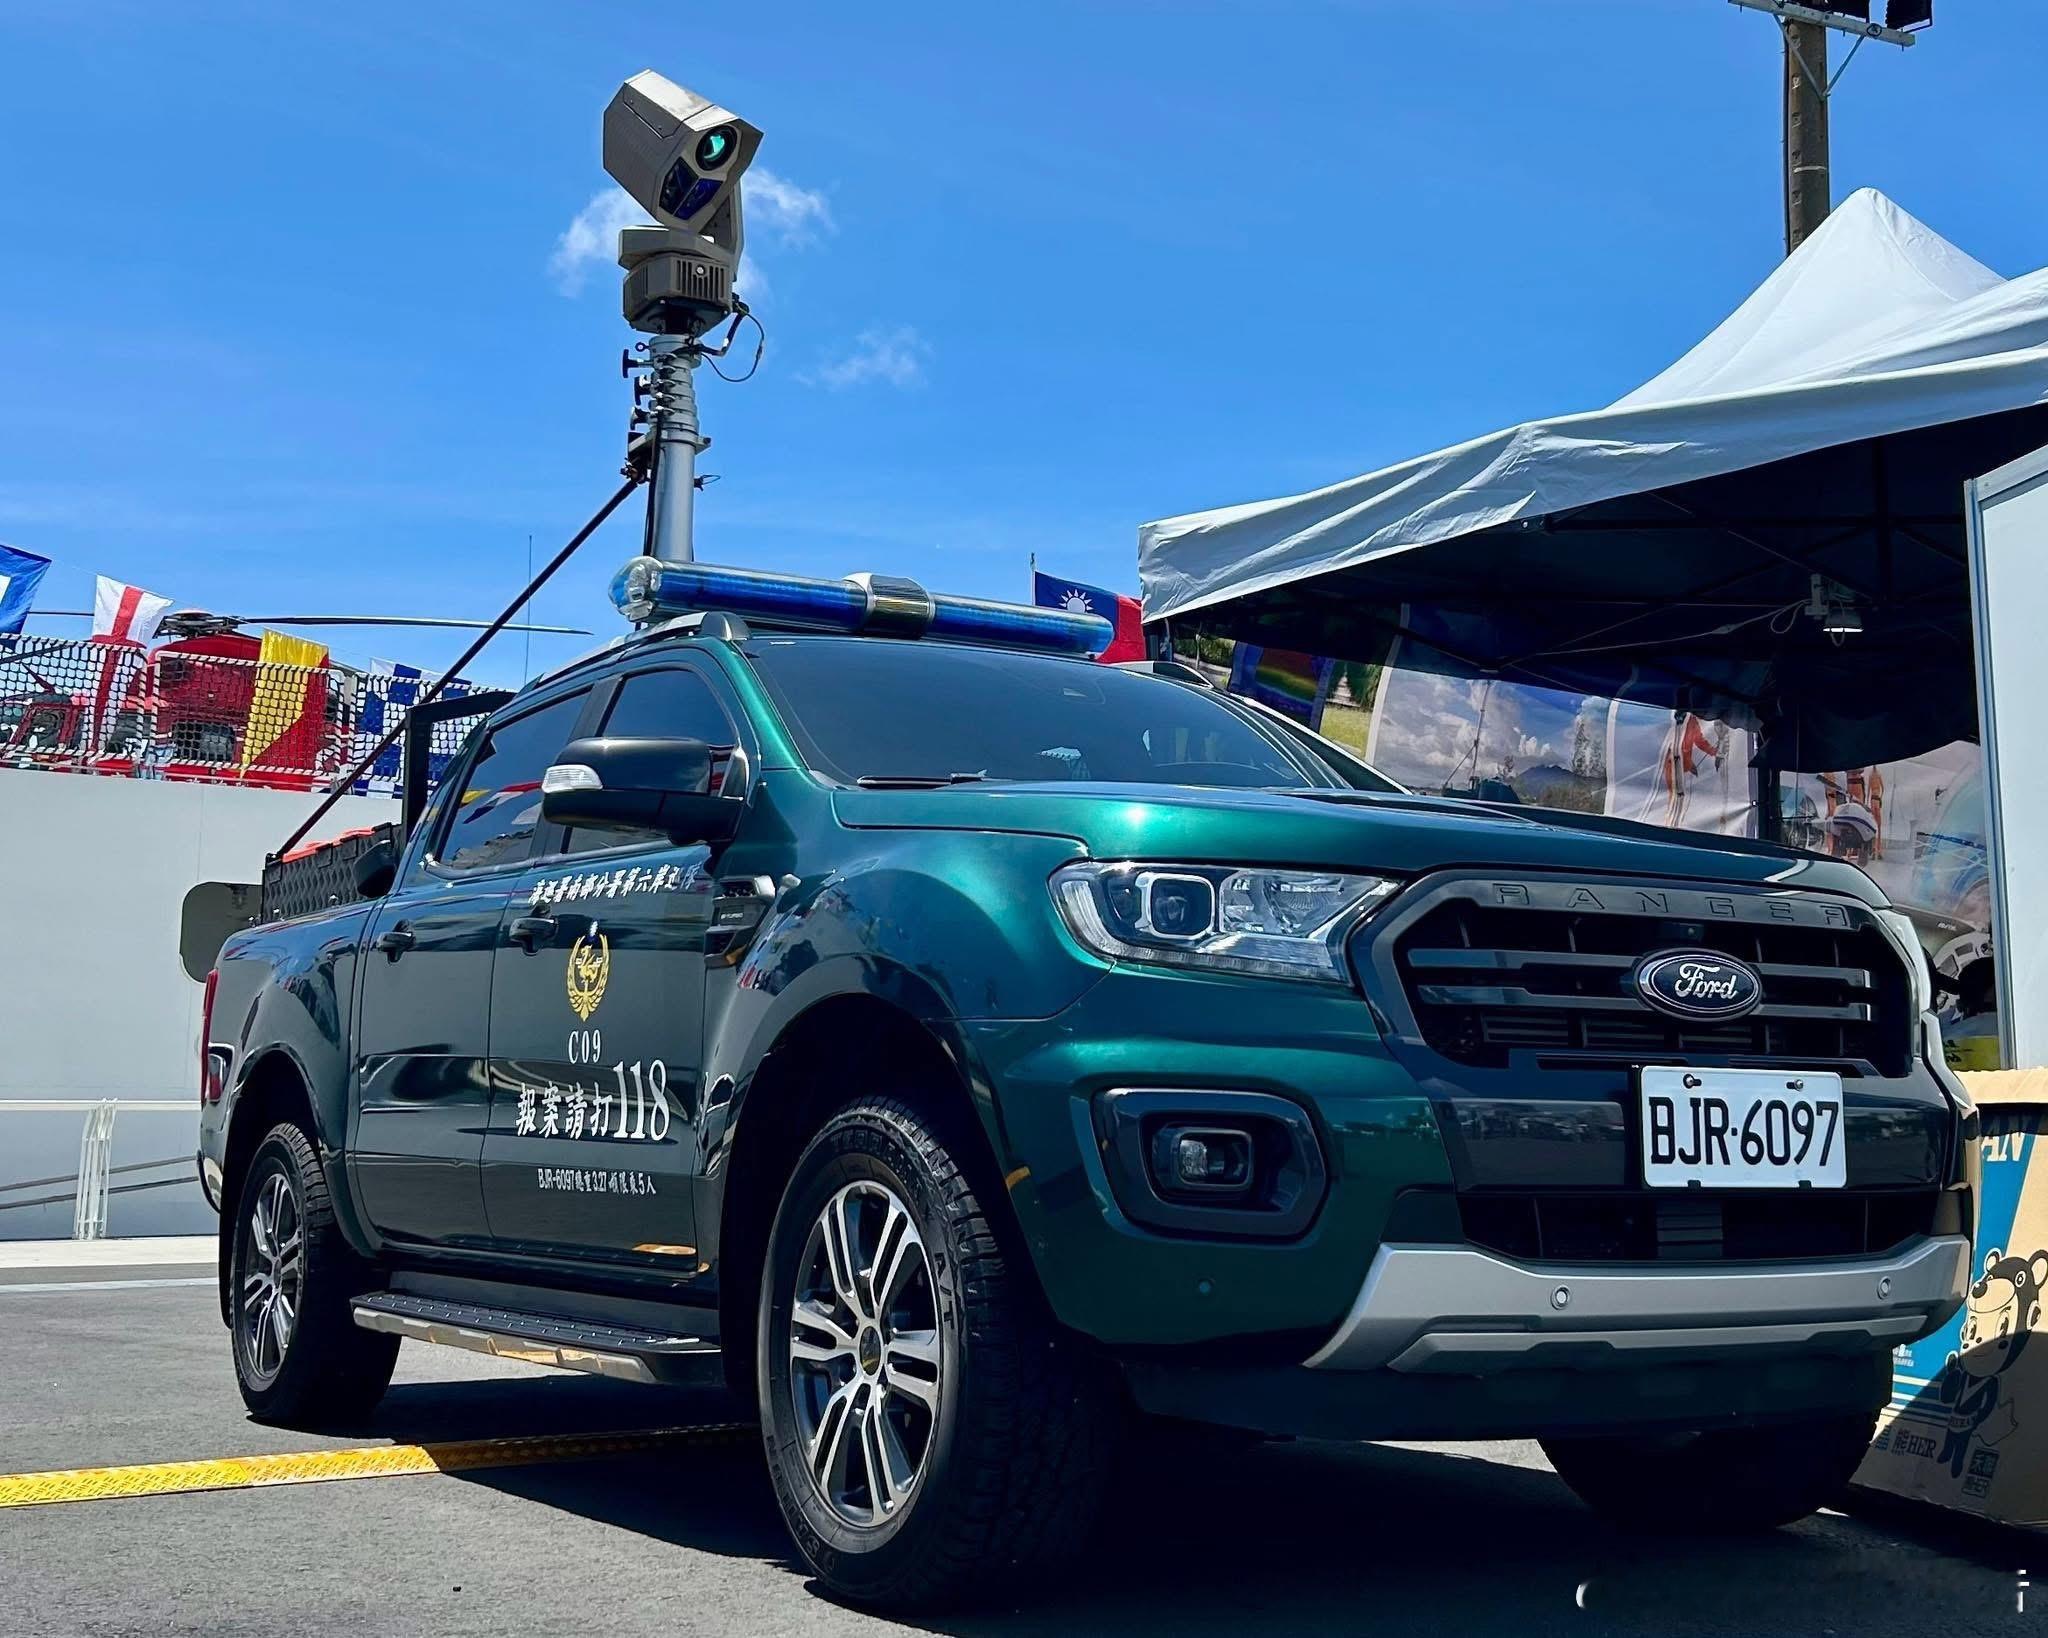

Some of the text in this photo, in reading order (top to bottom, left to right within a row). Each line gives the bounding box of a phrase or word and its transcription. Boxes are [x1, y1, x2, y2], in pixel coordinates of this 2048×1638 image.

[1492, 882, 1850, 928] RANGER
[1674, 962, 1739, 1000] Ford
[568, 1029, 601, 1065] C09
